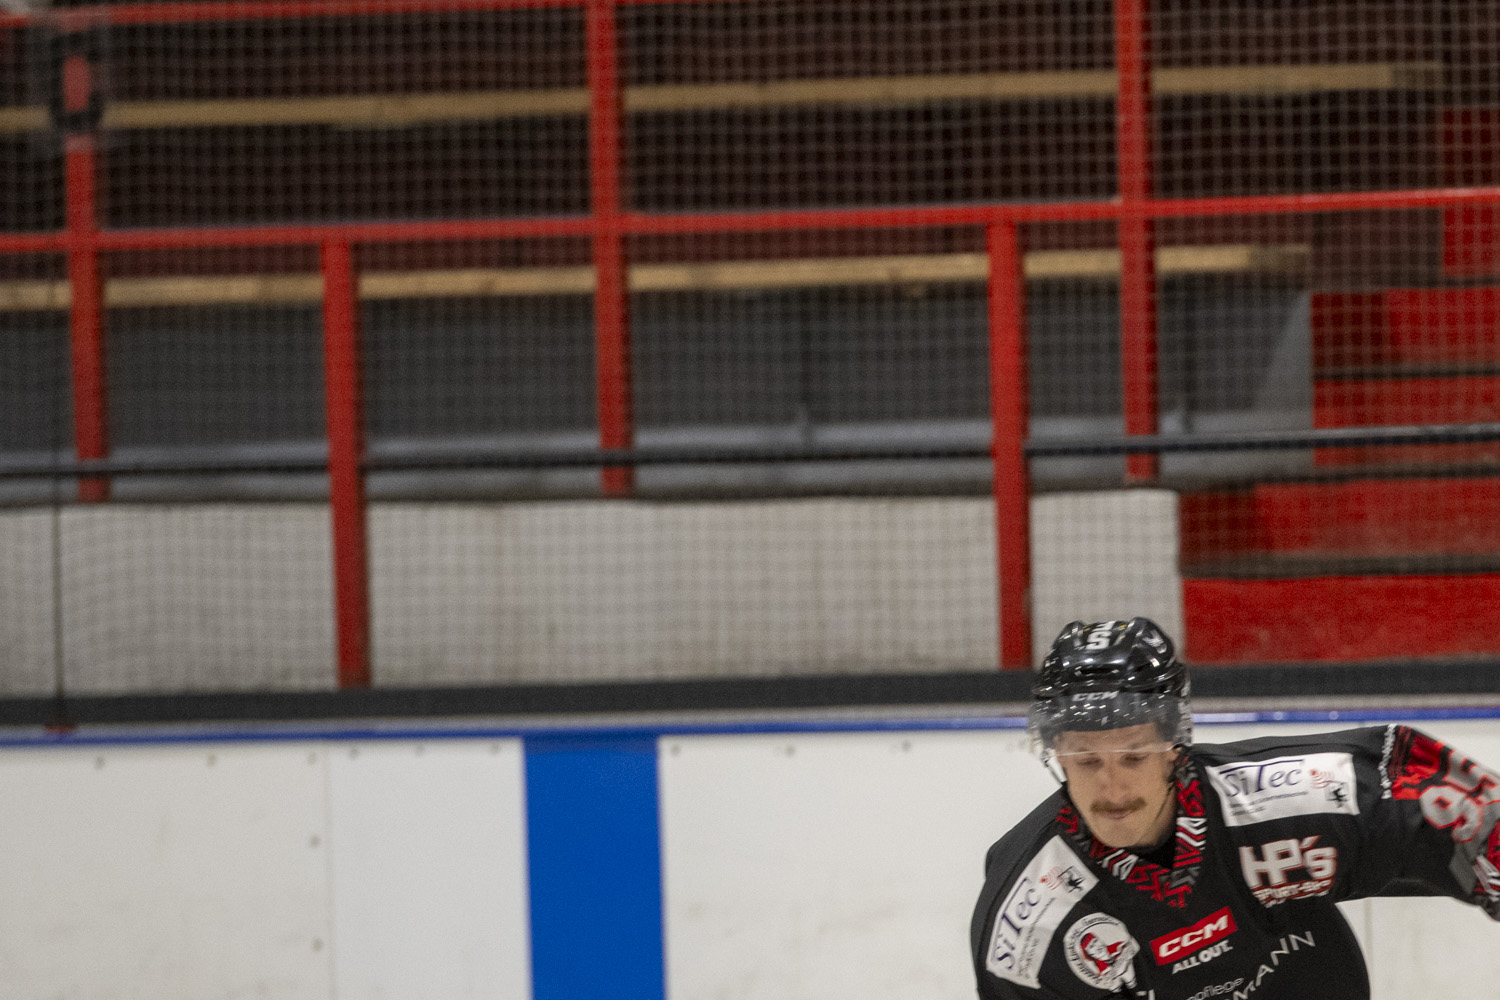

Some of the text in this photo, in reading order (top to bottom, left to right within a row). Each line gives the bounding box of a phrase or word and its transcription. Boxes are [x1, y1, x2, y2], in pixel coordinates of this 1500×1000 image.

[1072, 690, 1119, 701] CCM
[1219, 758, 1304, 797] SiTec
[1159, 915, 1228, 957] CCM
